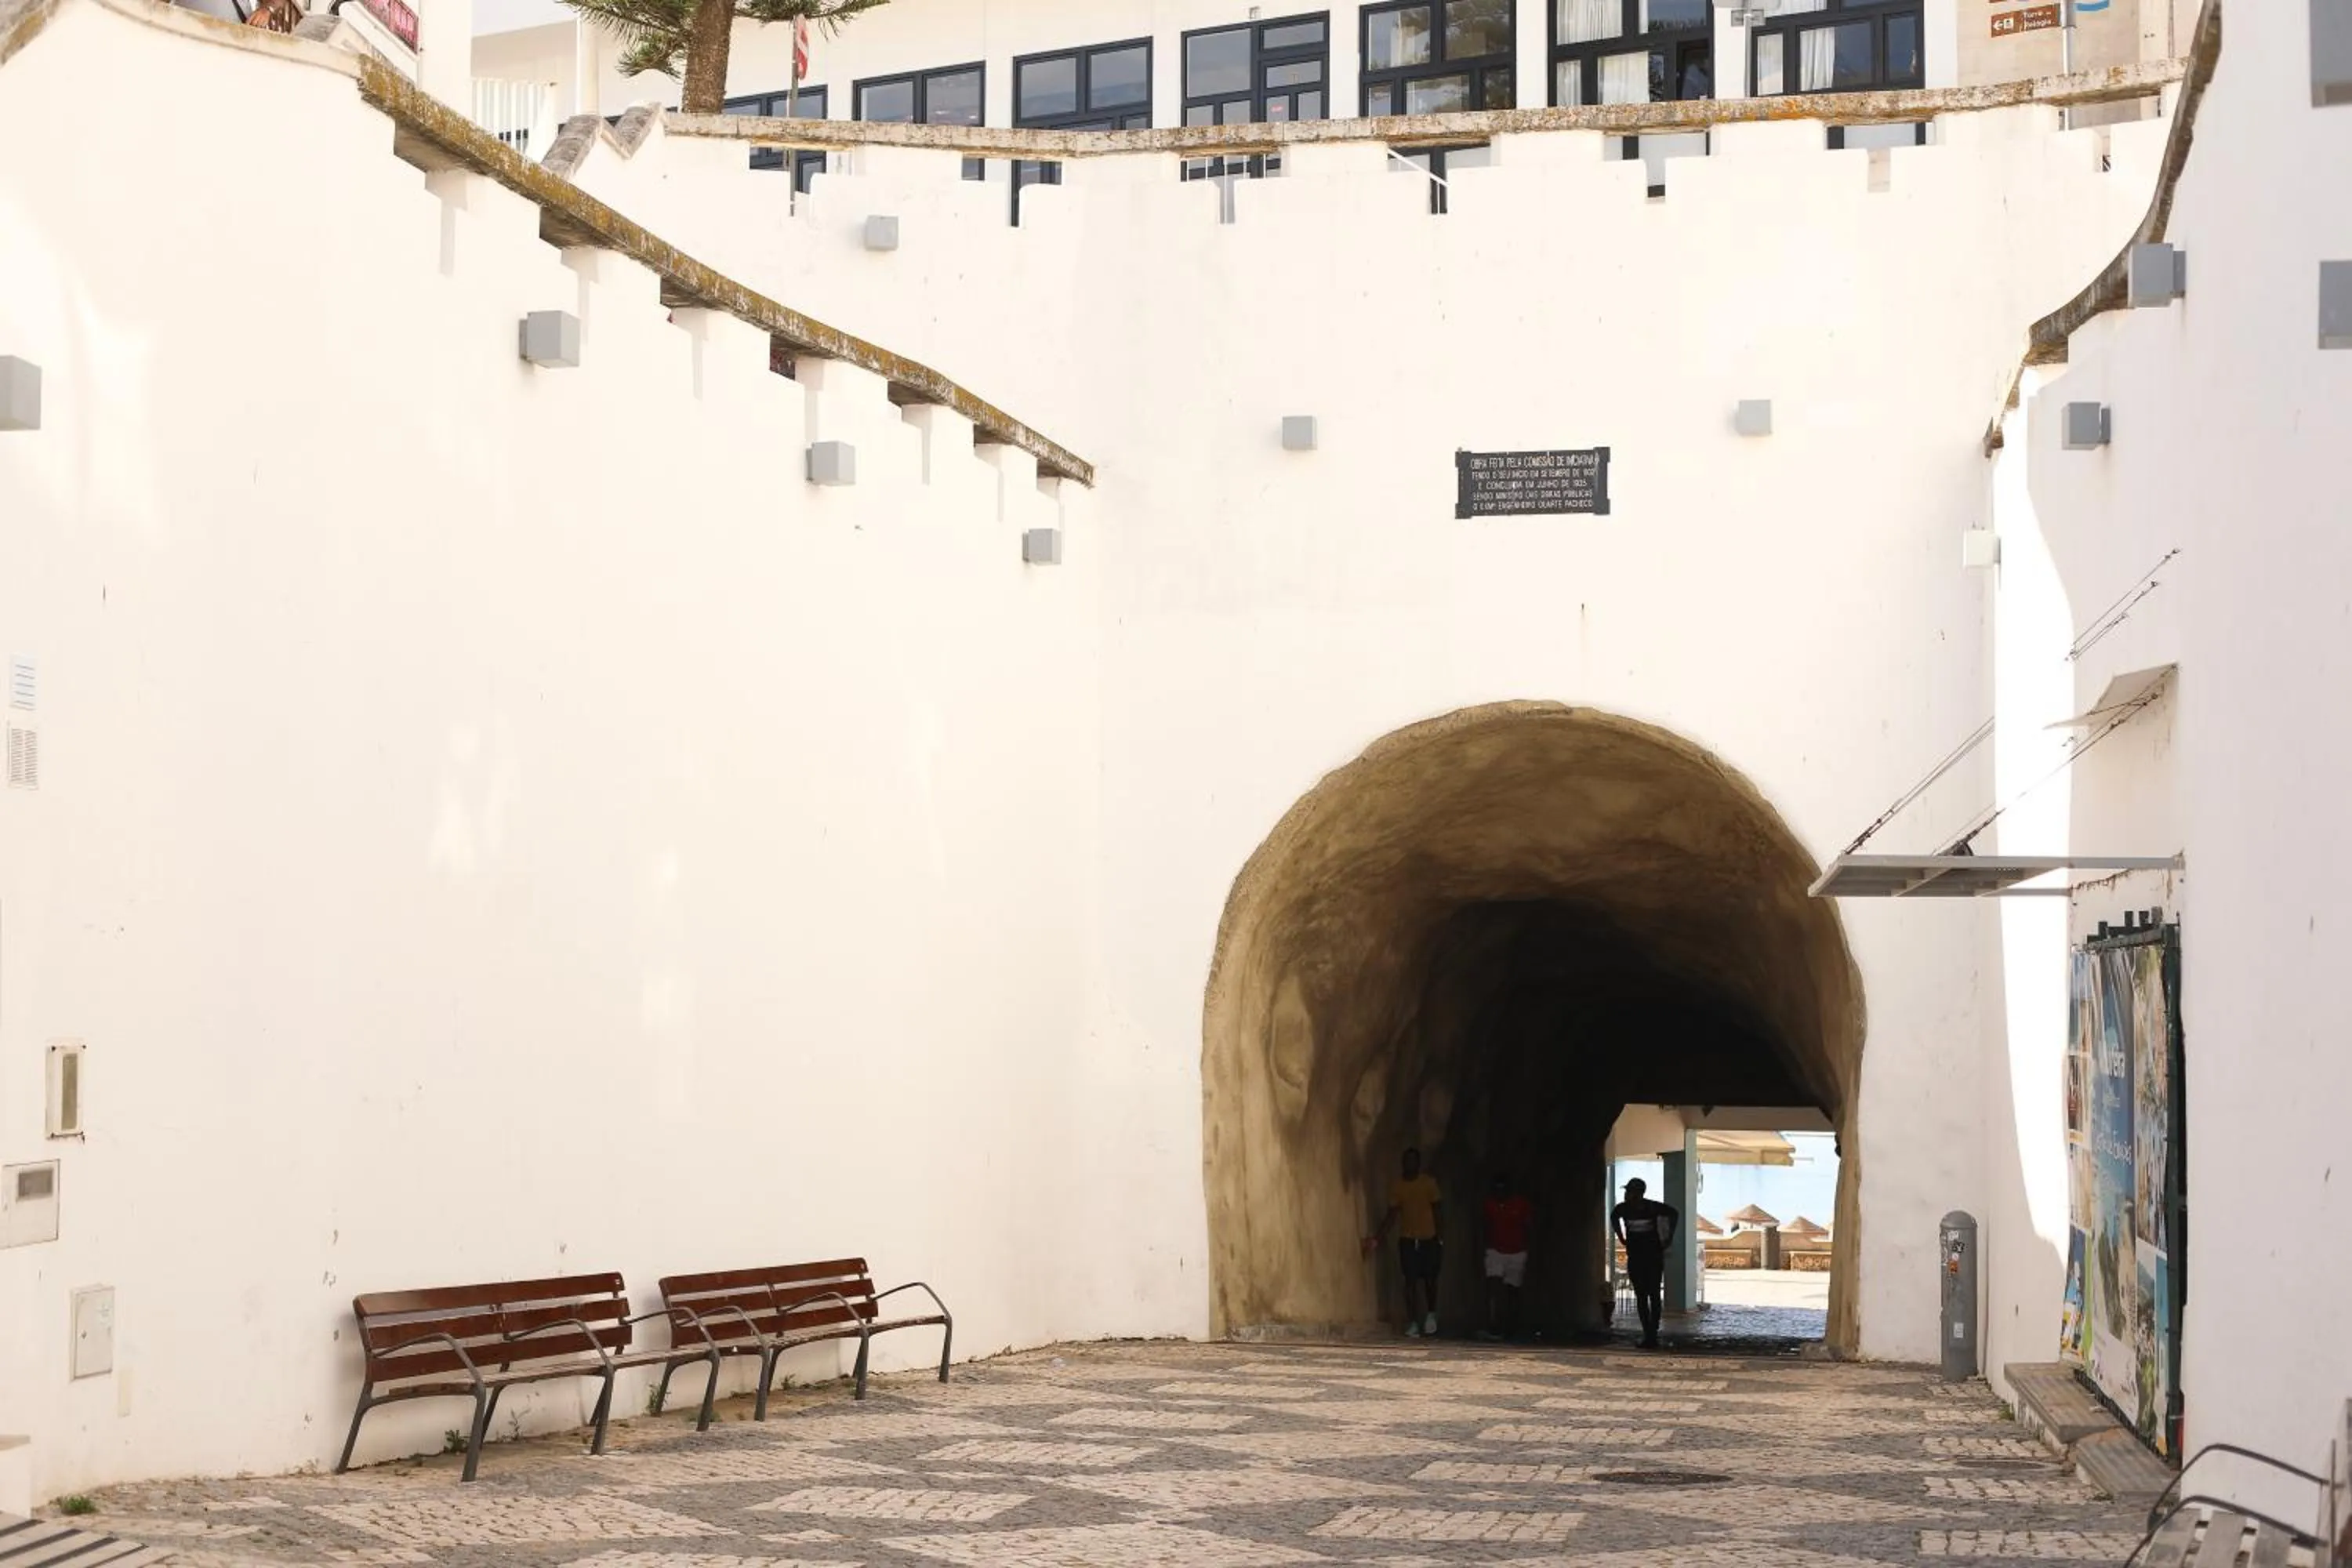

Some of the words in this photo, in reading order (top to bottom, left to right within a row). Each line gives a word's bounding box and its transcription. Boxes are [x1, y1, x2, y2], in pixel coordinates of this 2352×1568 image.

[1471, 458, 1487, 470] OBRA
[1489, 457, 1504, 468] FEITA
[1506, 456, 1523, 468] PELA
[1556, 455, 1565, 466] DE
[1498, 470, 1511, 480] SEU
[1572, 468, 1580, 477] DE
[1525, 480, 1534, 488] EM
[1561, 478, 1570, 488] DE
[1564, 498, 1593, 508] PACHECO
